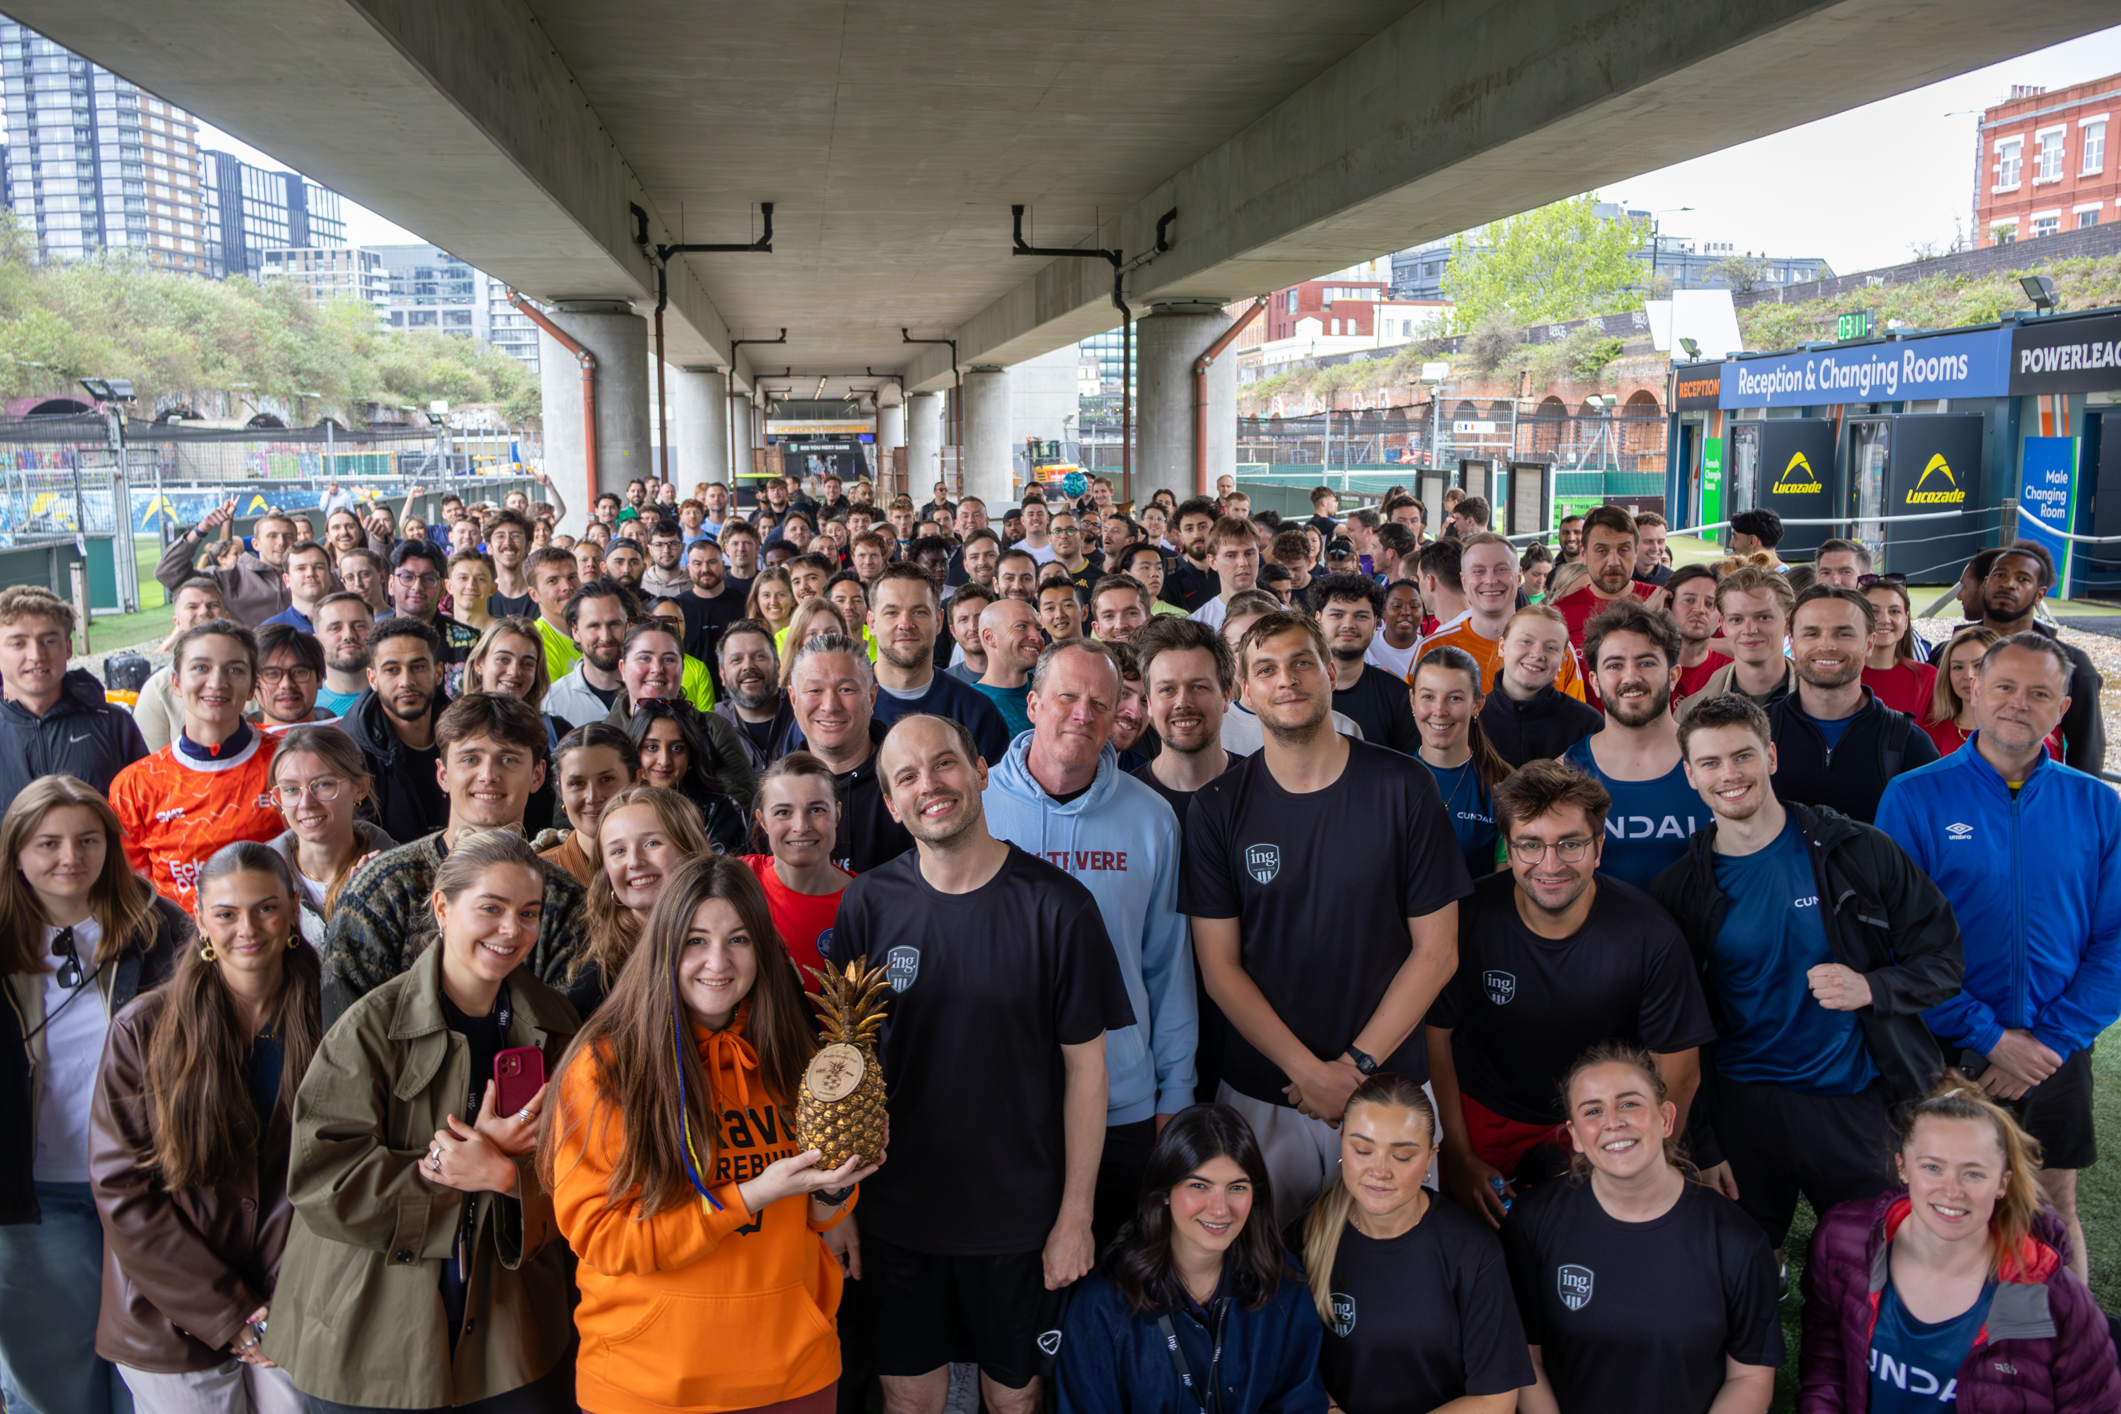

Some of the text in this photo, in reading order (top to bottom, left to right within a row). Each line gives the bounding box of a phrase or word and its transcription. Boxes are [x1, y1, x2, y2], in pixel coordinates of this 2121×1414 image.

[1738, 350, 1968, 402] Reception & Changing Rooms
[1679, 379, 1720, 398] RECEPTION
[844, 425, 870, 433] STREET
[2046, 469, 2068, 484] Male
[1772, 480, 1822, 494] Lucozade
[1905, 488, 1966, 504] Lucozade
[2025, 485, 2067, 506] Changing
[2040, 503, 2065, 519] Room
[1457, 811, 1496, 824] CUNDAL
[1250, 849, 1278, 867] ing.
[891, 951, 916, 974] ing.
[1562, 1269, 1590, 1293] ing.
[1330, 1297, 1353, 1320] ng.
